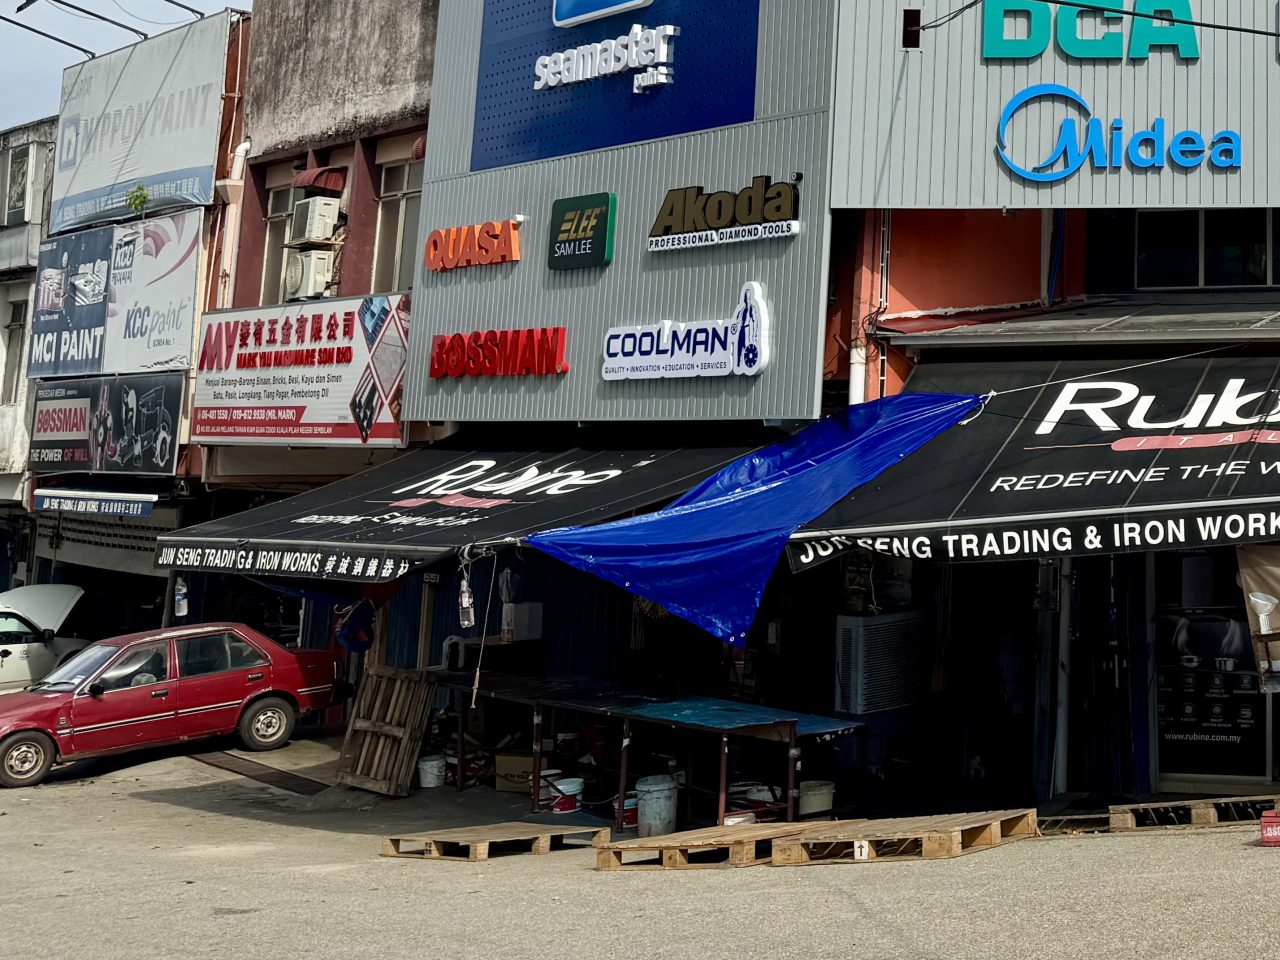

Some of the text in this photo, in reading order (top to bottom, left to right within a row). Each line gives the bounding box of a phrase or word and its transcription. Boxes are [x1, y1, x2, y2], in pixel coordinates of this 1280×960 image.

[533, 24, 681, 90] seamaster
[632, 66, 674, 94] paint
[152, 83, 213, 137] PAINT
[997, 83, 1242, 182] Midea
[649, 175, 798, 237] Akoda
[424, 218, 521, 272] QUASA
[554, 240, 592, 257] SAM LEE
[649, 222, 792, 250] PROFESSIONAL DIAMOND TOOLS
[115, 244, 135, 270] KCC
[124, 298, 188, 349] KCC paint
[32, 326, 104, 363] MCI PAINT
[199, 320, 240, 371] MY
[429, 326, 569, 378] BOSSMAN
[606, 325, 729, 358] COOLMAN
[237, 352, 258, 369] MARK
[273, 349, 316, 367] HARDWARE
[318, 347, 335, 364] SDN
[336, 346, 353, 363] BHD
[604, 361, 727, 374] QUALITY INNOVATION EDUCATION SERVICES
[301, 373, 314, 386] Kayu
[315, 373, 326, 383] dan
[326, 373, 342, 382] Simen
[263, 389, 275, 400] Tiang
[290, 388, 320, 400] Pembetong
[37, 407, 87, 433] BOSSMAN
[278, 409, 296, 421] MARK)
[31, 449, 88, 461] THE POWER OF WILL
[990, 467, 1165, 493] REDEFINE
[1180, 460, 1250, 479] THE
[942, 526, 1078, 558] TRADING
[1084, 525, 1103, 548] &
[1115, 518, 1186, 546] IRON
[159, 548, 174, 565] JUN
[176, 548, 202, 566] SENG
[245, 551, 253, 568] &
[256, 550, 280, 570] IRON
[281, 551, 321, 573] WORKS
[1165, 732, 1242, 744] www.rubine.com.my
